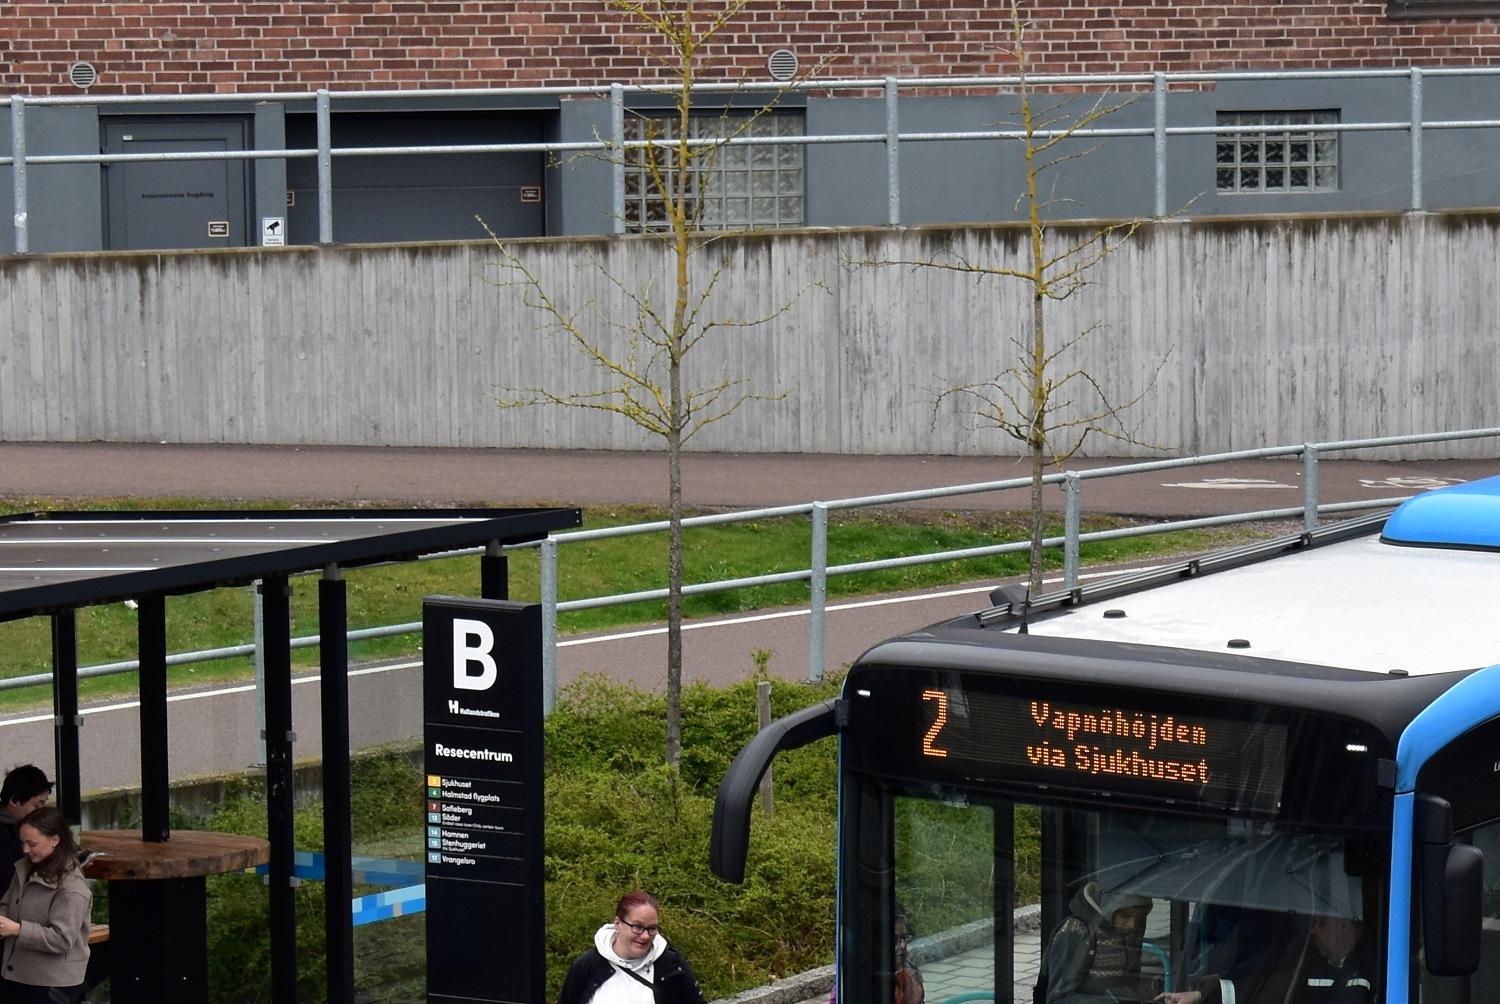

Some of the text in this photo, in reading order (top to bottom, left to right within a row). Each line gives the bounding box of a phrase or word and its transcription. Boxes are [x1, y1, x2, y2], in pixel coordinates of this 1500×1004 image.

[453, 618, 497, 691] B
[922, 690, 947, 758] 2
[1031, 702, 1207, 749] Vapnöhöjden
[435, 744, 513, 762] Resecentrum
[1027, 741, 1208, 784] via Sjukhuset
[442, 778, 472, 788] Sjukhuset
[442, 790, 472, 800] Halmstad
[473, 792, 500, 803] flygplats
[442, 813, 461, 821] Söder
[442, 830, 469, 839] Hamnen
[442, 839, 486, 850] Stenhuggeriet
[442, 855, 476, 866] Vrangelsro
